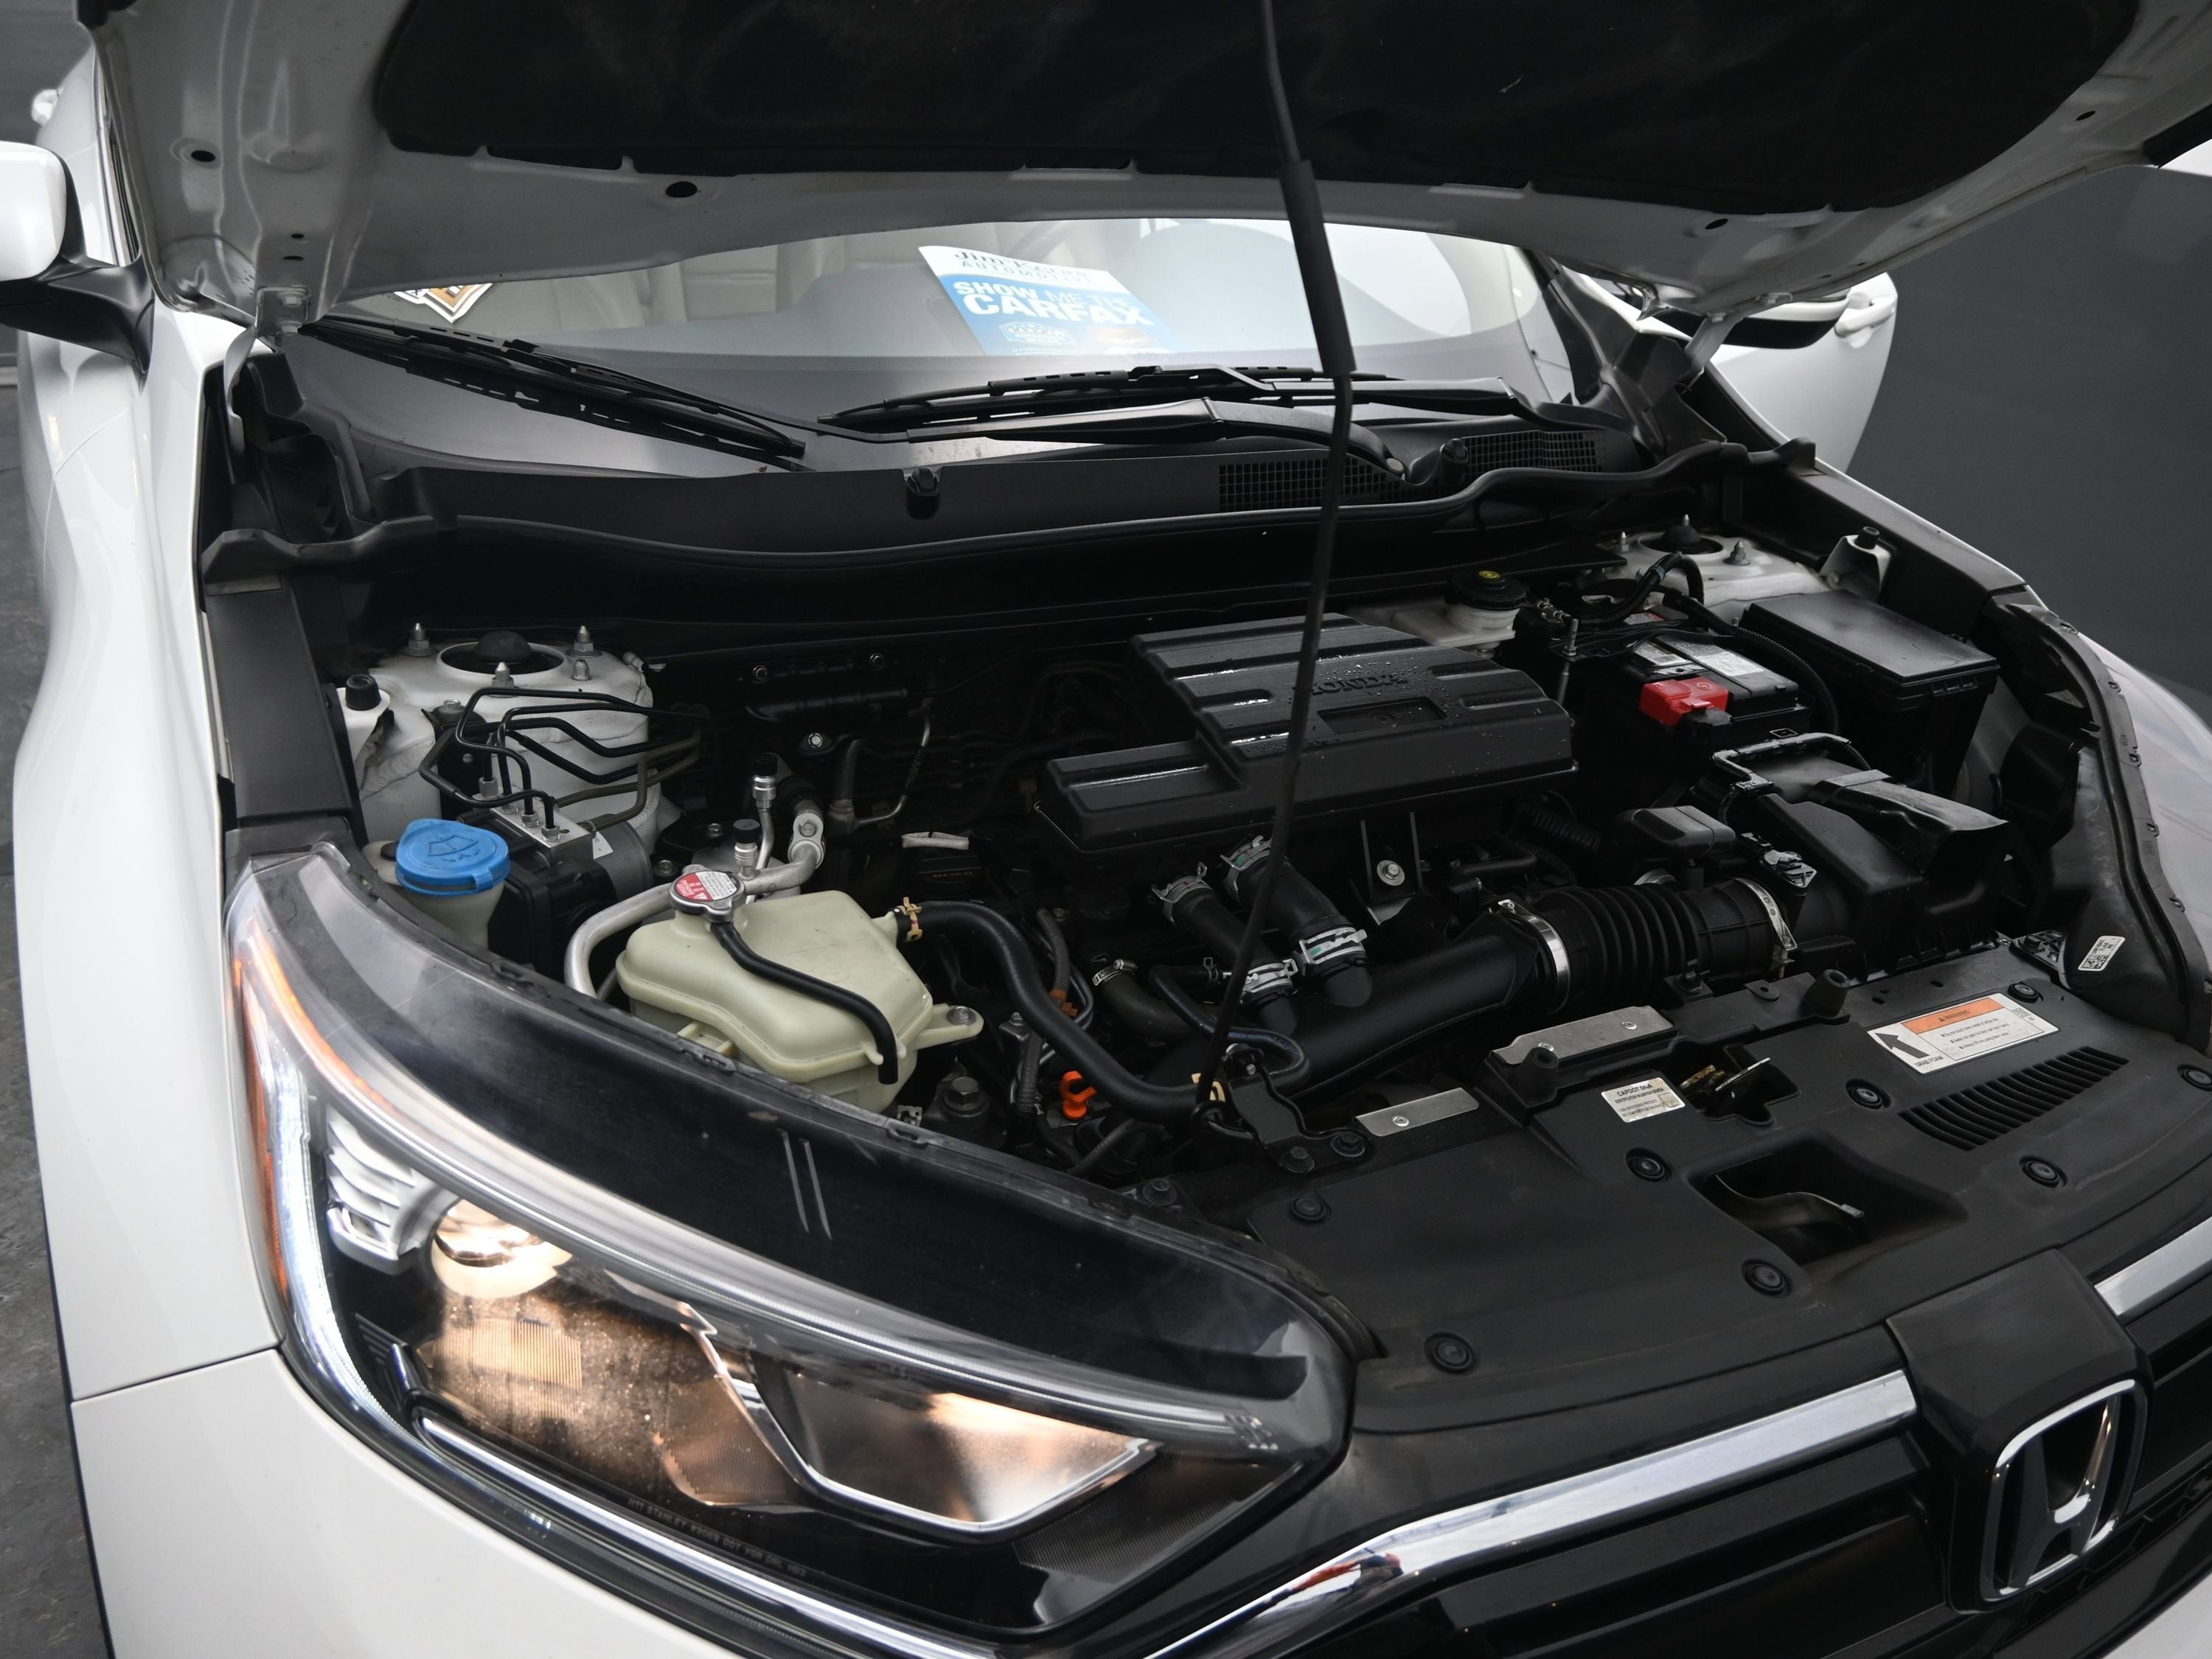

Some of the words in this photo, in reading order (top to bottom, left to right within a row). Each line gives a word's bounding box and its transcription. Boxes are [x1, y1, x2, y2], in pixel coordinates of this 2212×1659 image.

[962, 260, 1091, 284] AUTOMOTIVE
[953, 281, 1039, 300] SHOW
[1044, 291, 1082, 305] ME
[1088, 295, 1136, 309] THE
[962, 293, 1156, 326] CARFAX
[1915, 1058, 1930, 1068] GRAB
[1617, 1087, 1639, 1096] CAPDOT
[647, 1506, 687, 1528] STANLEY
[723, 1537, 741, 1550] DOT
[765, 1554, 782, 1569] DRL
